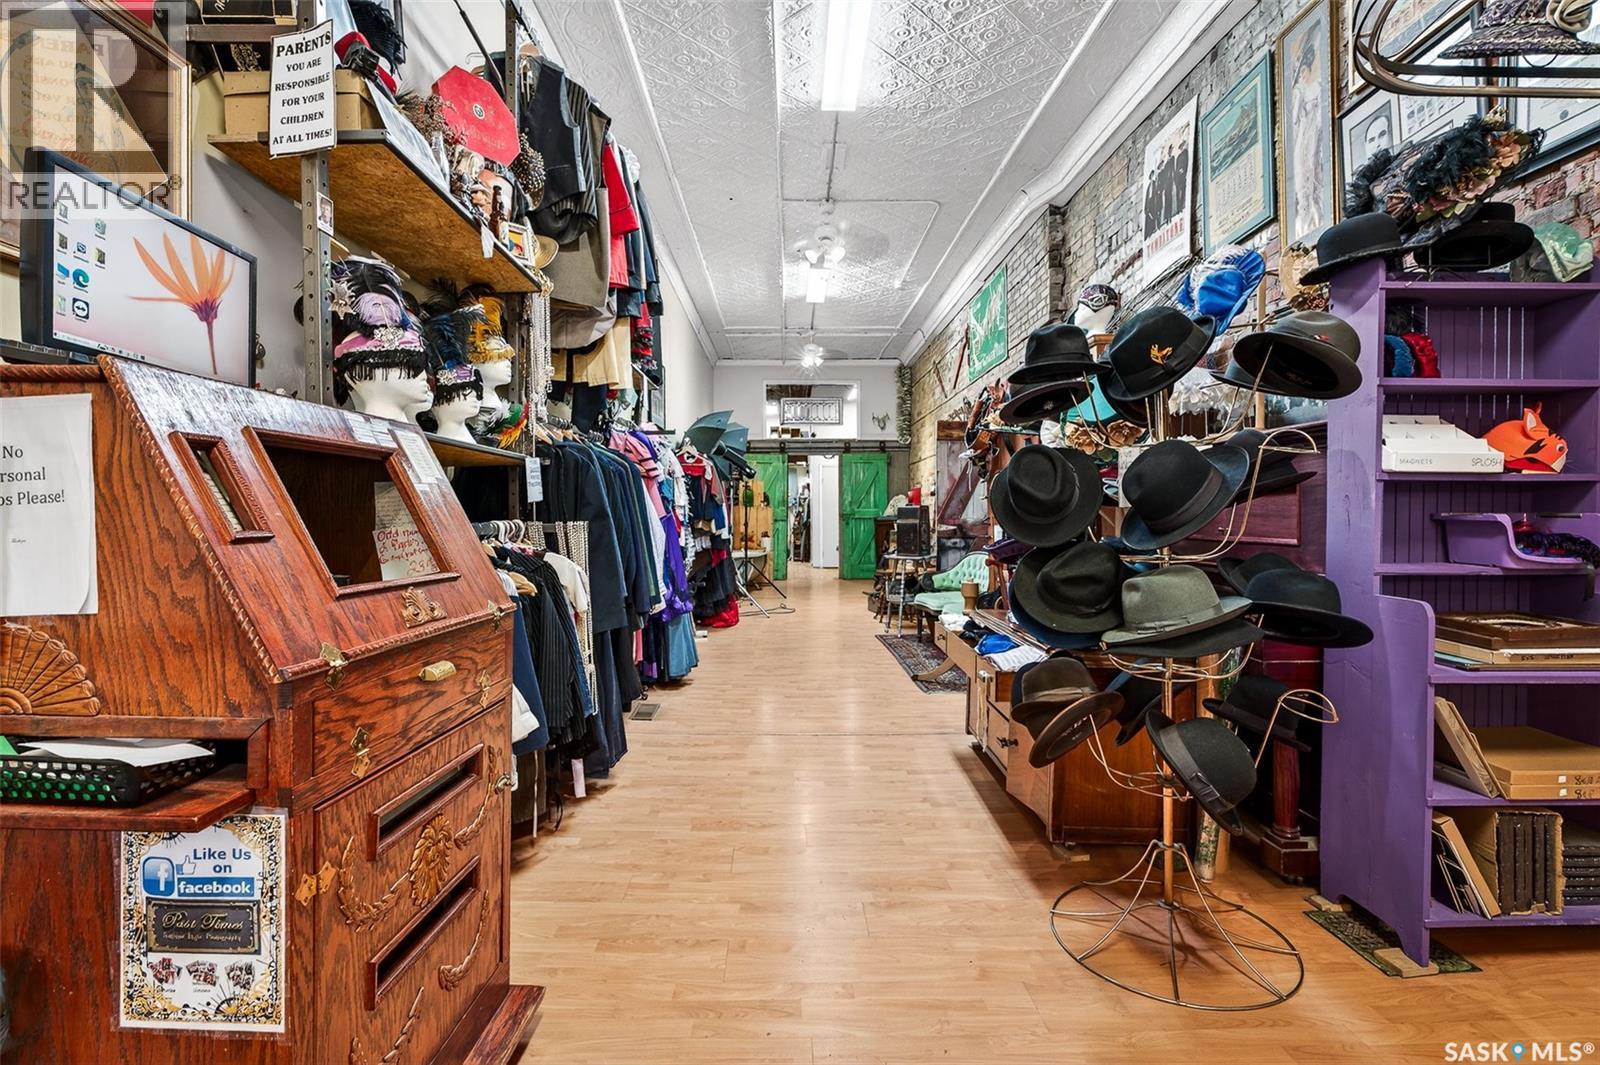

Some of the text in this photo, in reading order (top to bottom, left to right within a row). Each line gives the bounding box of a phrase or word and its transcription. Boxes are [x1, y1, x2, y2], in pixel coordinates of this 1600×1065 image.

[276, 30, 332, 58] PARENTS
[286, 57, 322, 73] YOU ARE
[274, 72, 330, 92] RESPONSIBLE
[281, 92, 325, 108] FOR YOUR
[280, 110, 324, 126] CHILDREN
[272, 128, 333, 145] AT ALL TIMES!
[2, 445, 24, 459] No
[0, 466, 46, 483] rsonal
[17, 489, 65, 506] Please!
[193, 847, 252, 860] Like Us
[212, 864, 232, 874] on
[178, 880, 252, 894] facebook
[162, 911, 244, 930] Past Times
